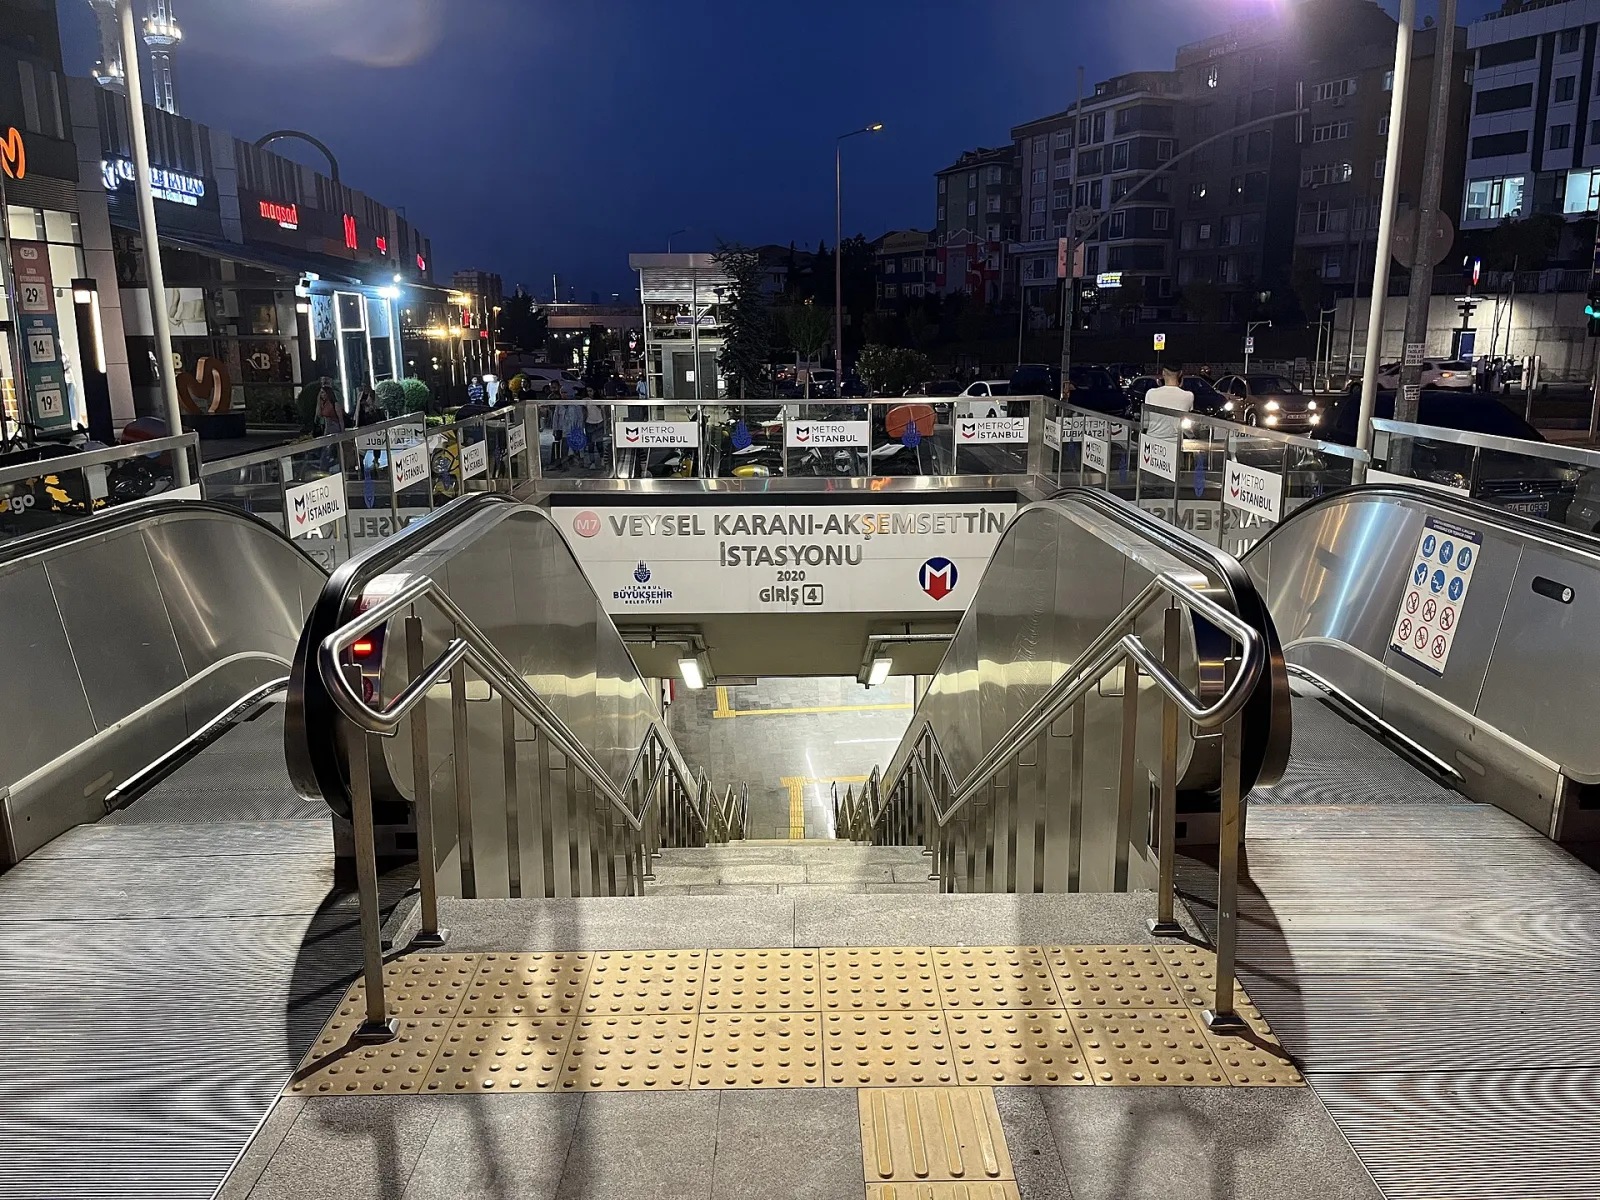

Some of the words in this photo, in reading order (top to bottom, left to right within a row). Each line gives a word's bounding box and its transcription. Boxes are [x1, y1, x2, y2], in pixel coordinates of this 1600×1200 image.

[259, 201, 298, 224] maqsad
[26, 287, 38, 302] 29
[33, 340, 45, 355] 14
[41, 395, 53, 410] 19
[641, 426, 675, 434] METRO
[812, 425, 845, 433] METRO
[977, 421, 1011, 430] METRO
[641, 434, 689, 443] İSTANBUL
[812, 433, 858, 442] İSTANBUL
[977, 430, 1023, 439] İSTANBUL
[1150, 443, 1166, 458] METRO
[403, 453, 418, 467] METRO
[1150, 455, 1172, 473] İSTANBUL
[403, 464, 425, 481] İSTANBUL
[1241, 473, 1264, 491] METRO
[305, 485, 329, 503] METRO
[1240, 486, 1273, 512] İSTANBUL
[307, 499, 340, 522] İSTANBUL
[577, 519, 598, 531] M7
[608, 514, 706, 536] VEYSEL
[714, 507, 1006, 540] KARANI-AKŞEMSETTİN
[720, 541, 863, 567] İSTASYONU
[777, 570, 806, 582] 2020
[613, 588, 673, 602] BÜYÜKŞEHİR
[759, 585, 800, 605] GİRİŞ
[807, 588, 819, 602] 4
